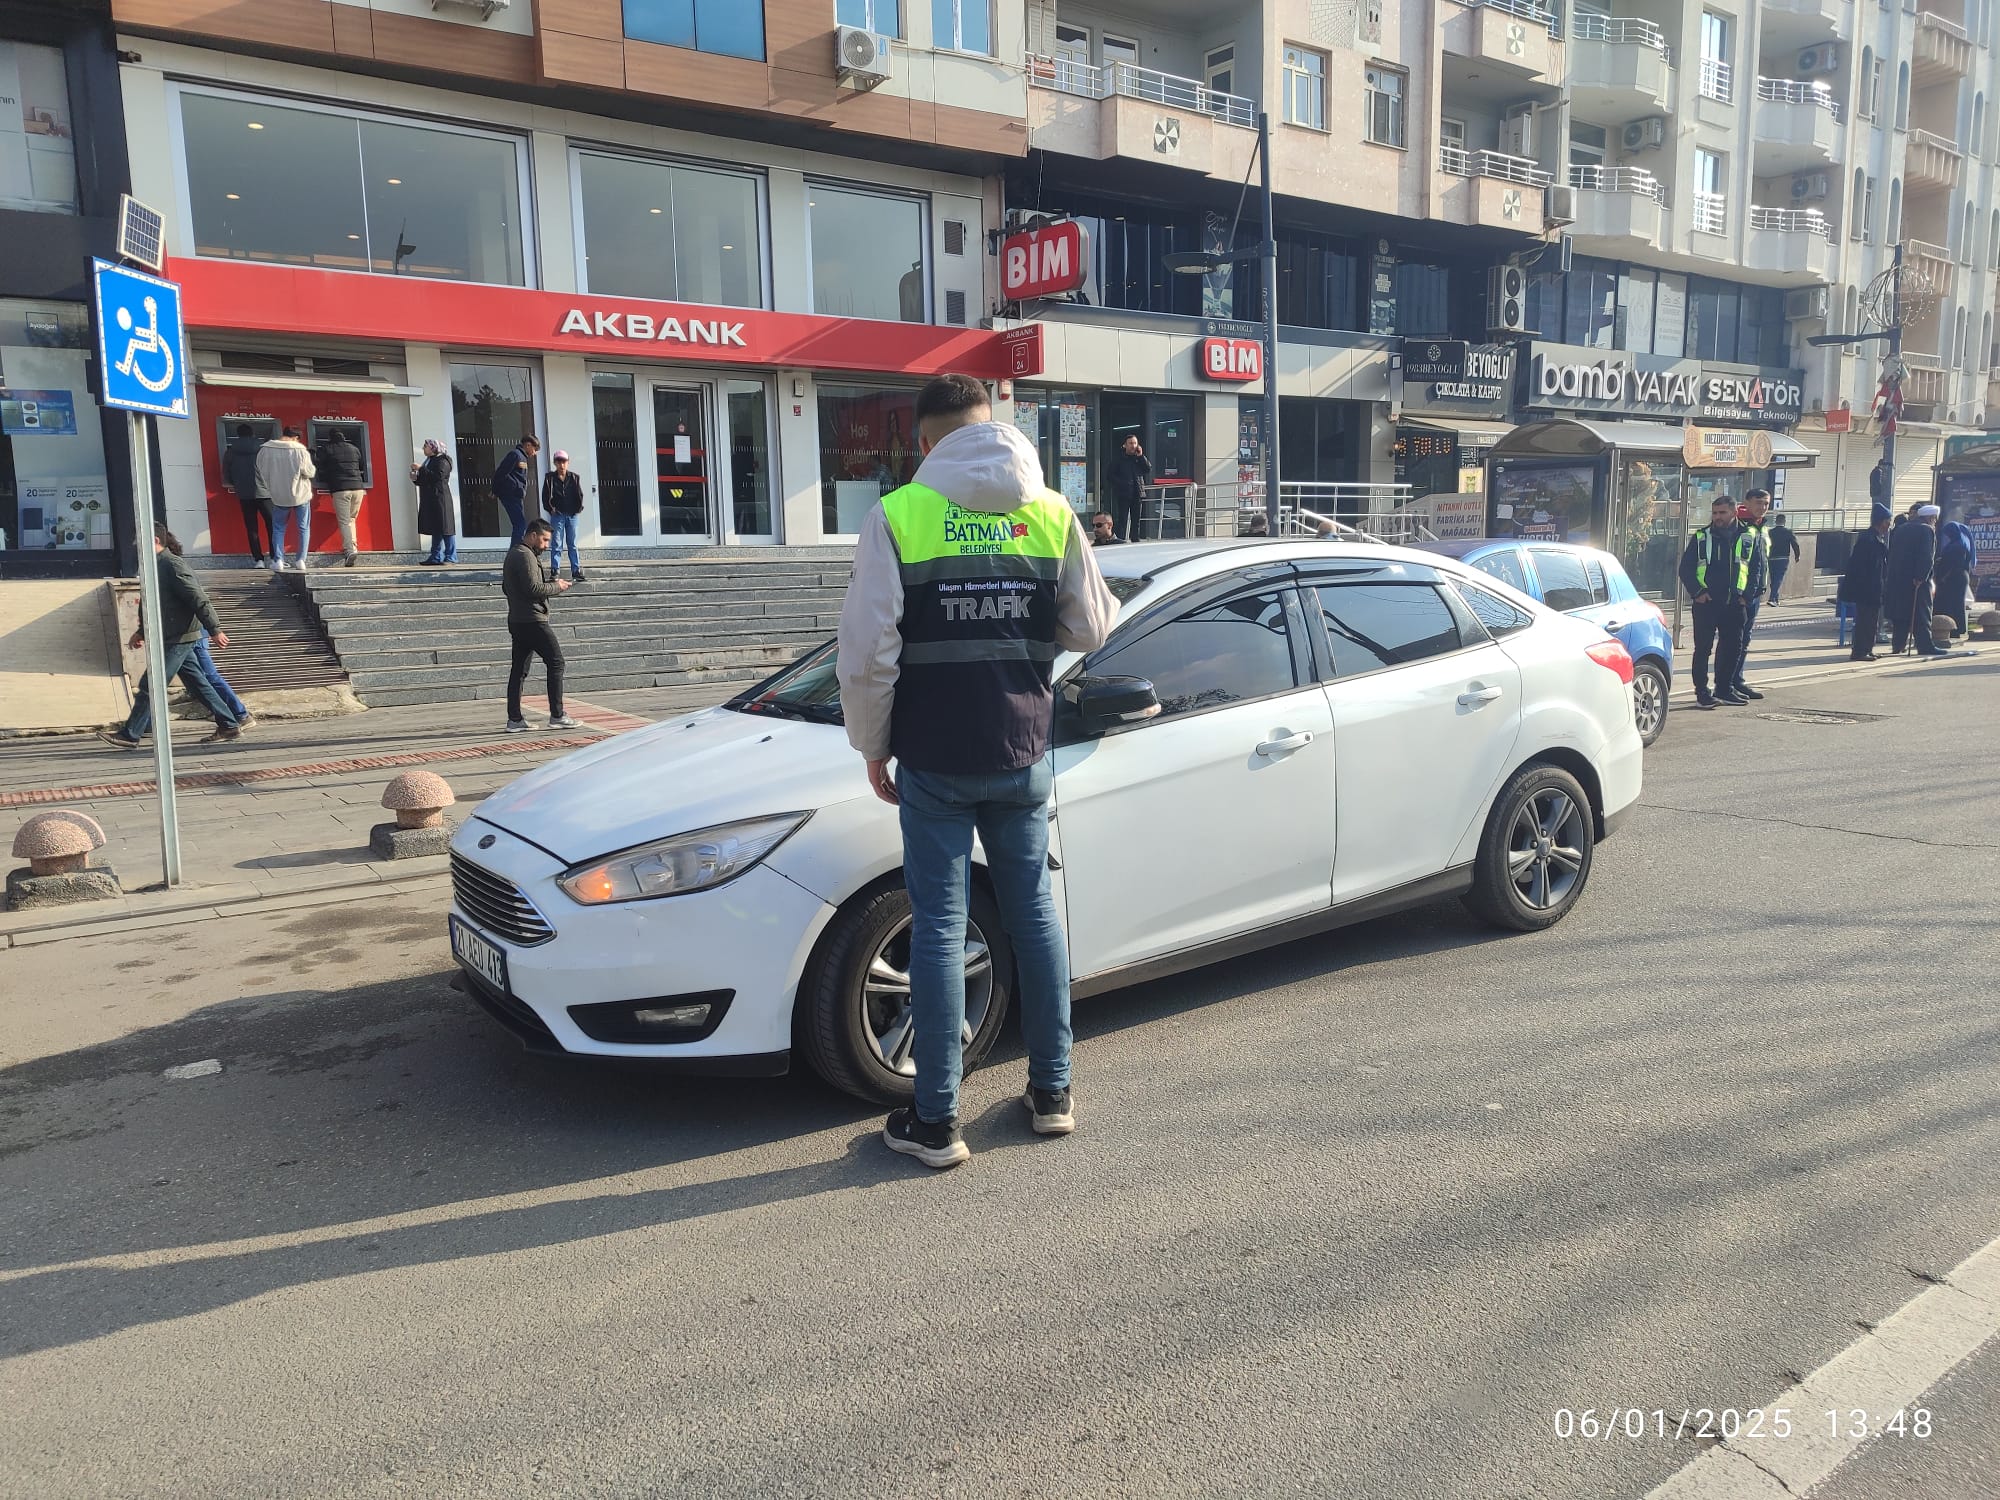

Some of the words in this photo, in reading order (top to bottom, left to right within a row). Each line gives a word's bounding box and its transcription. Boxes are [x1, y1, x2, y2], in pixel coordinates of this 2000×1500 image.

[1007, 230, 1069, 288] BİM
[560, 309, 747, 346] AKBANK
[1006, 328, 1034, 339] AKBANK
[1016, 361, 1025, 370] 24
[1210, 340, 1258, 374] BİM
[1540, 352, 1627, 400] bambi
[1471, 384, 1478, 397] &
[1478, 384, 1502, 400] KAHVE
[1632, 369, 1699, 405] YATAK
[1707, 377, 1801, 408] SENATÖR
[1704, 406, 1751, 420] Bilgisayar
[1758, 410, 1799, 422] Teknoloji
[851, 423, 869, 441] Hoş
[26, 488, 38, 497] 20
[66, 489, 78, 498] 20
[1437, 513, 1465, 524] FABRİKA
[943, 520, 1015, 542] BATMAN
[1441, 527, 1480, 537] MAĞAZASI
[960, 542, 1002, 554] BELEDİYESİ
[938, 583, 962, 593] Ulaşım
[964, 582, 1000, 591] Hizmetleri
[1002, 580, 1037, 591] Müdürlüğü
[941, 590, 1032, 621] TRAFİK
[487, 948, 503, 986] 413
